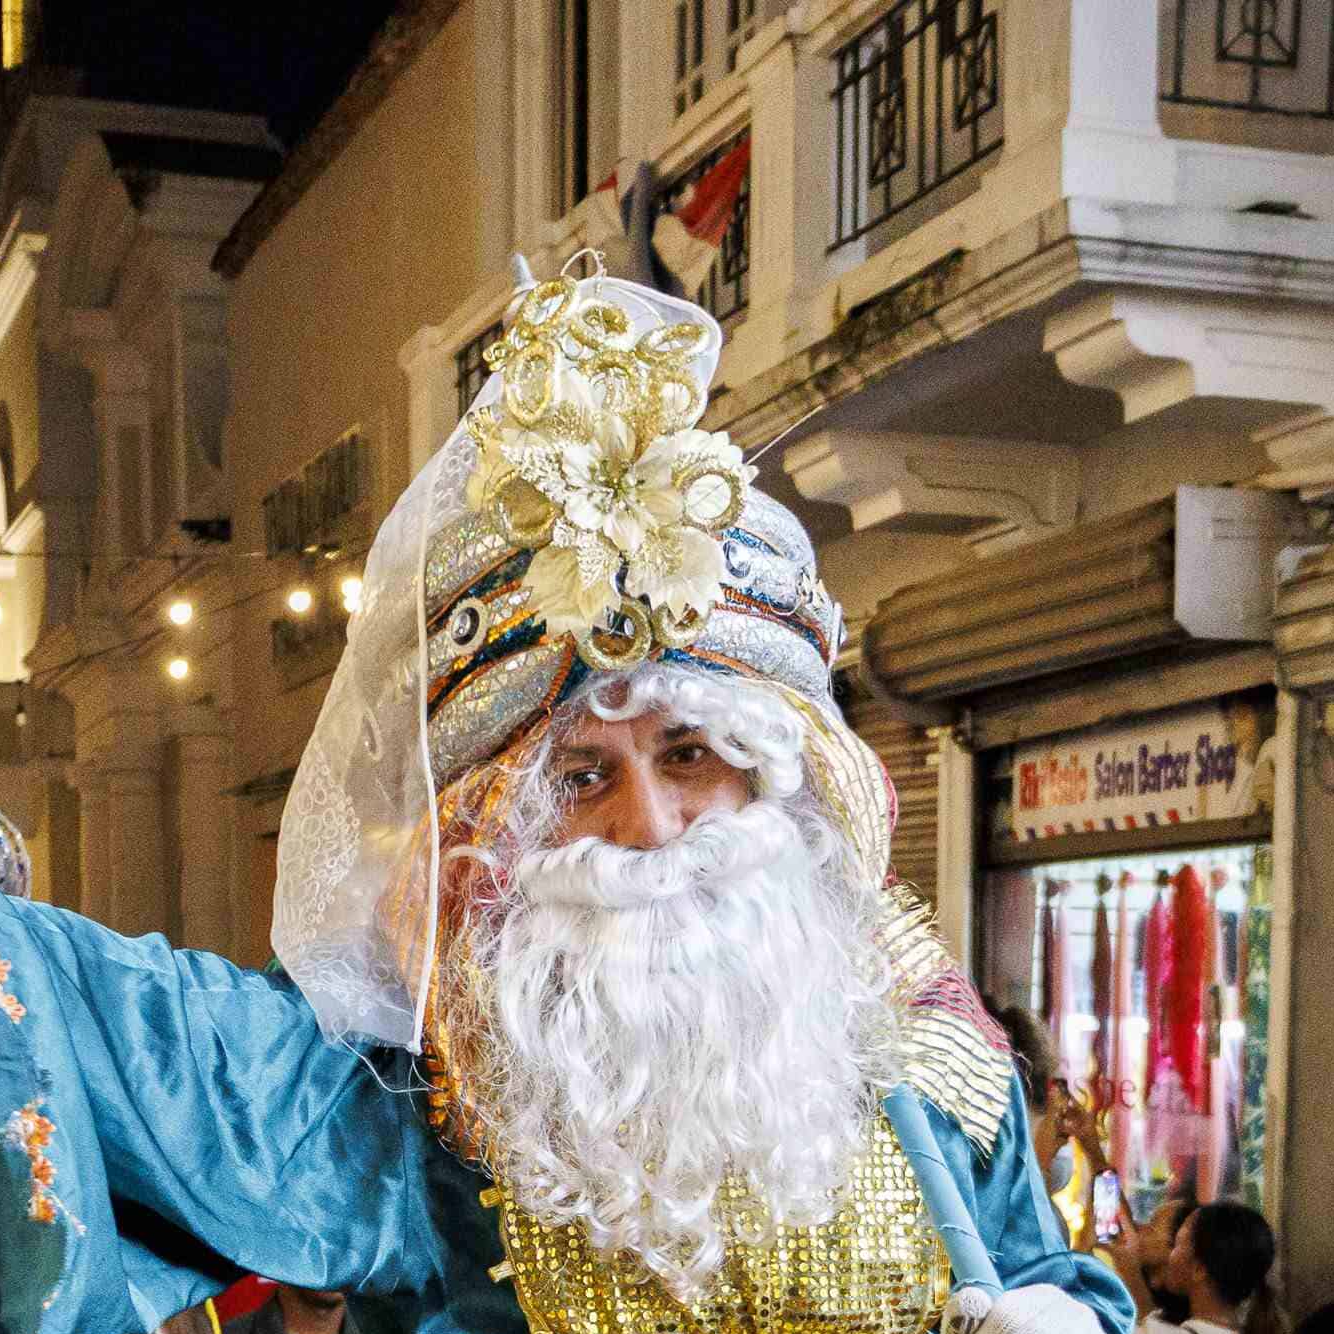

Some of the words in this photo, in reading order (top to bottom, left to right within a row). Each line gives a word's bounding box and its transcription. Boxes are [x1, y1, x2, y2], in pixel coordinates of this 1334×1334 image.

[1095, 750, 1134, 800] Salon
[1138, 741, 1190, 795] Barber
[1195, 734, 1237, 793] Shop
